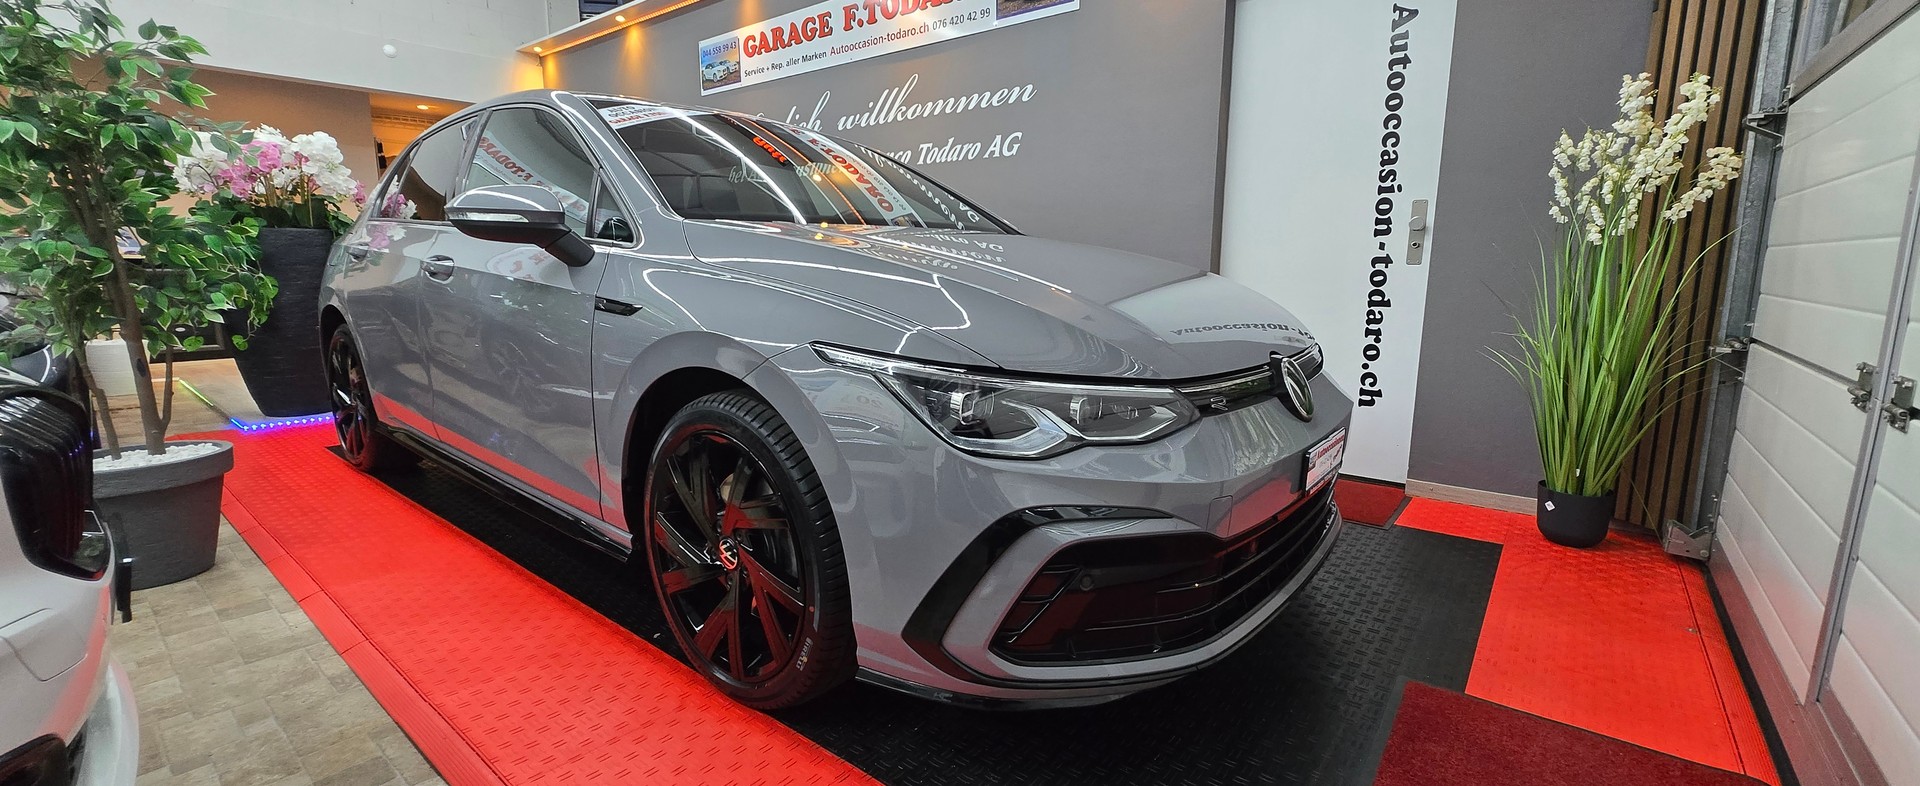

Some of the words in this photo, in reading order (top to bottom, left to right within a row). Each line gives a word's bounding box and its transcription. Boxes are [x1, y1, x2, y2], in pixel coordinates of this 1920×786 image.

[702, 48, 712, 58] 044
[712, 45, 722, 56] 558
[722, 43, 729, 54] 99
[729, 41, 737, 50] 43
[743, 11, 833, 58] GARAGE
[744, 65, 766, 78] Service
[771, 62, 785, 72] Rep.
[785, 57, 800, 67] aller
[801, 50, 827, 63] Marken
[829, 22, 930, 57] Autooccasion-todaro.ch
[932, 17, 947, 31] 076
[949, 13, 965, 28] 420
[966, 10, 978, 22] 42
[979, 7, 991, 19] 99
[837, 74, 1038, 131] willkommen
[917, 137, 982, 165] Todaro
[983, 131, 1023, 160] AG
